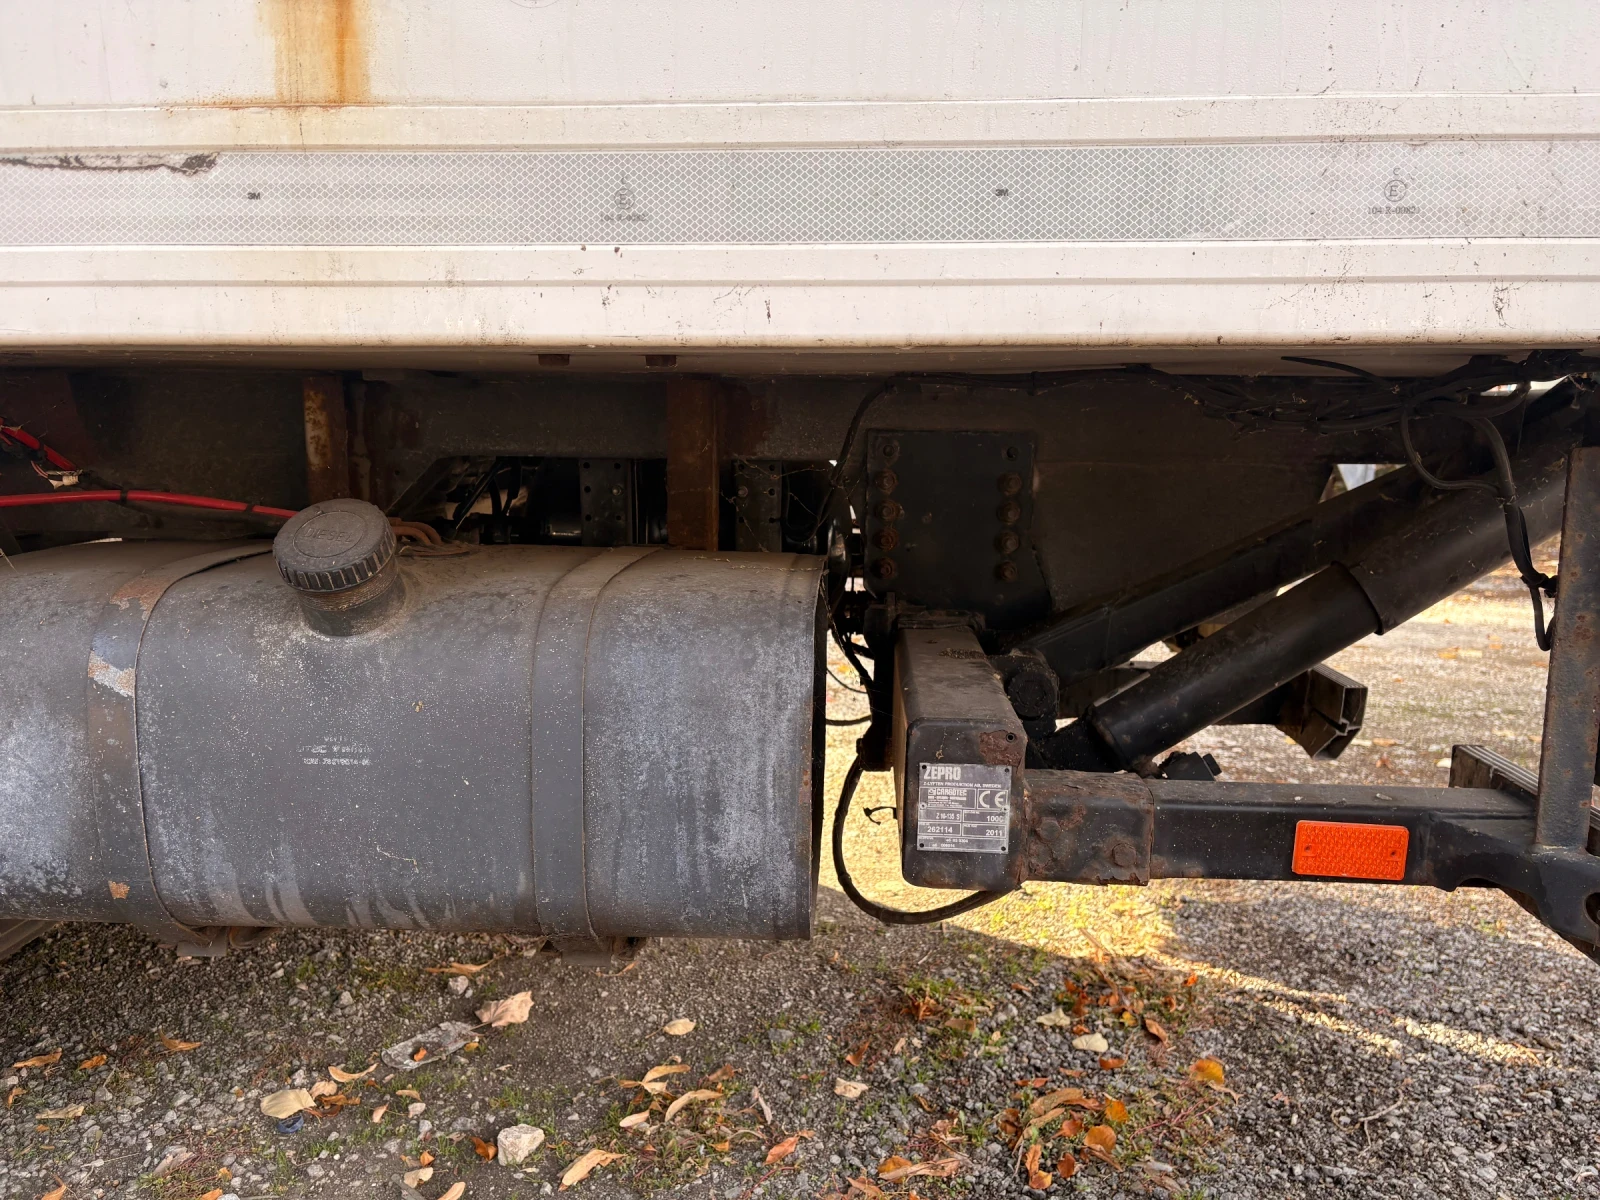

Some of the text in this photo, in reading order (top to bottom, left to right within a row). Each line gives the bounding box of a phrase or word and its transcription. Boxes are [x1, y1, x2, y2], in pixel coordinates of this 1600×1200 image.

[247, 192, 261, 200] 3M
[995, 188, 1009, 197] 3M
[302, 527, 354, 543] DIESEL
[923, 766, 962, 781] ZEPRO
[936, 788, 968, 797] CARGOTEC
